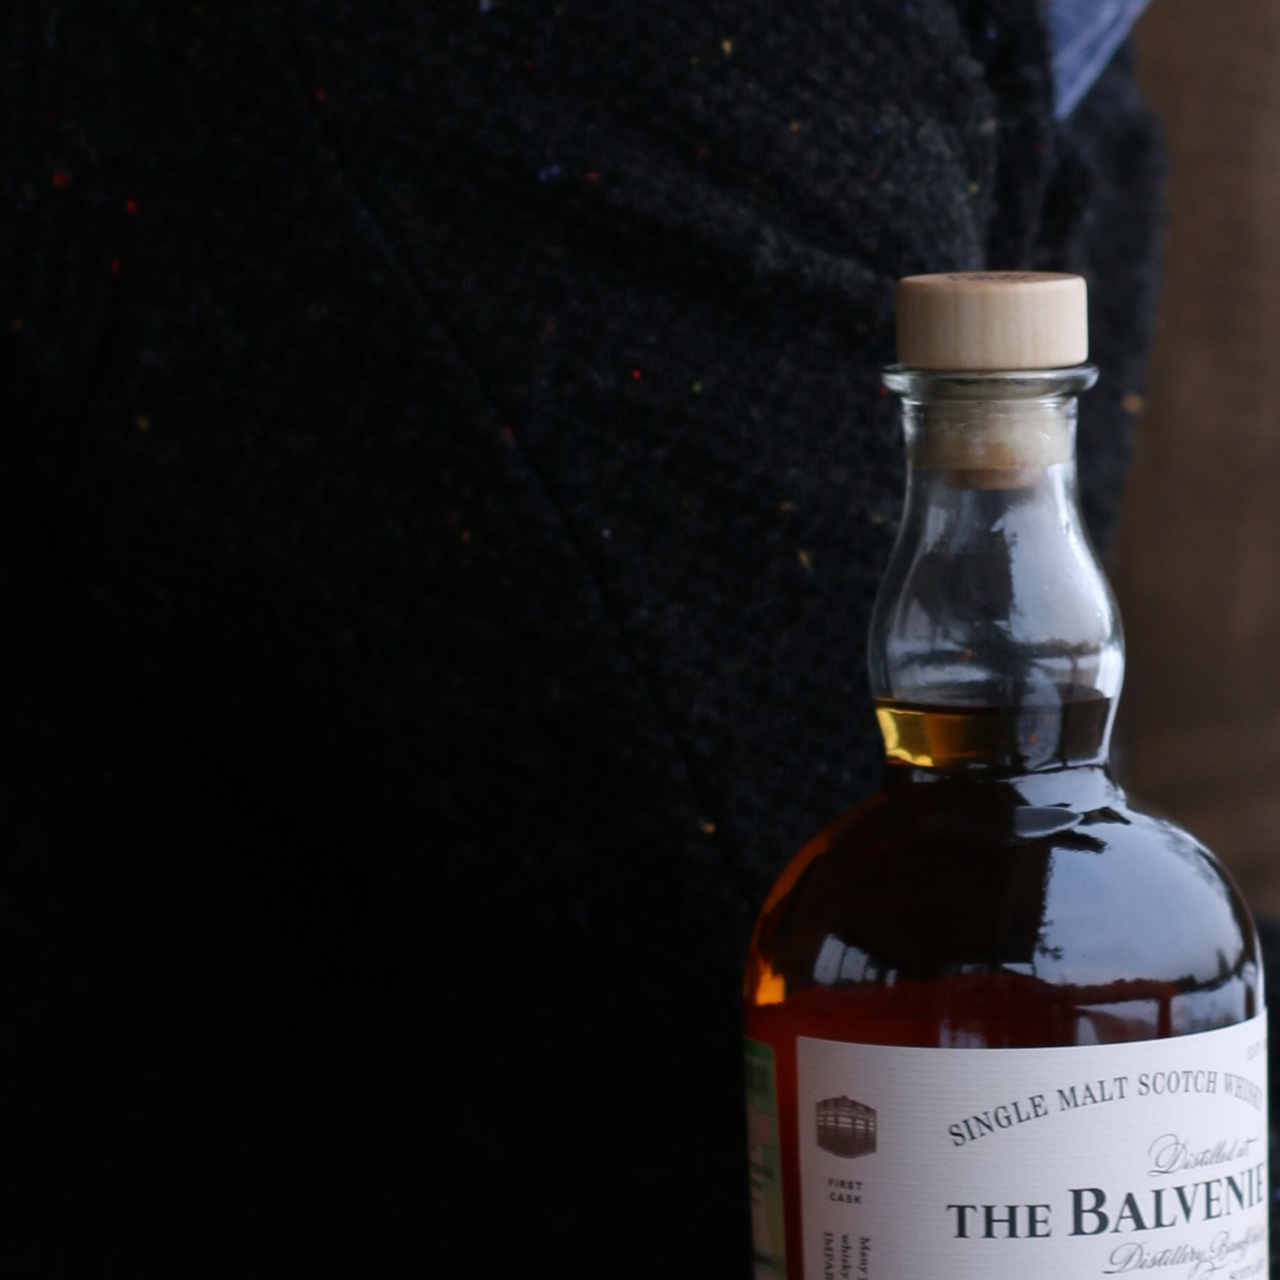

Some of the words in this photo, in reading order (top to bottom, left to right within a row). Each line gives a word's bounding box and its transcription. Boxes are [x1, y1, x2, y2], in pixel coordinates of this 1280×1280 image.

[947, 1094, 1050, 1148] SINGLE
[1057, 1076, 1129, 1112] MALT
[1138, 1069, 1218, 1097] SCOTCH
[1148, 1133, 1234, 1178] Distilled
[828, 1177, 863, 1191] FIRST
[829, 1192, 862, 1205] CASK
[946, 1203, 1052, 1240] THE
[1067, 1162, 1265, 1237] BALVENIE
[840, 1234, 853, 1279] whisky
[859, 1236, 872, 1274] Many
